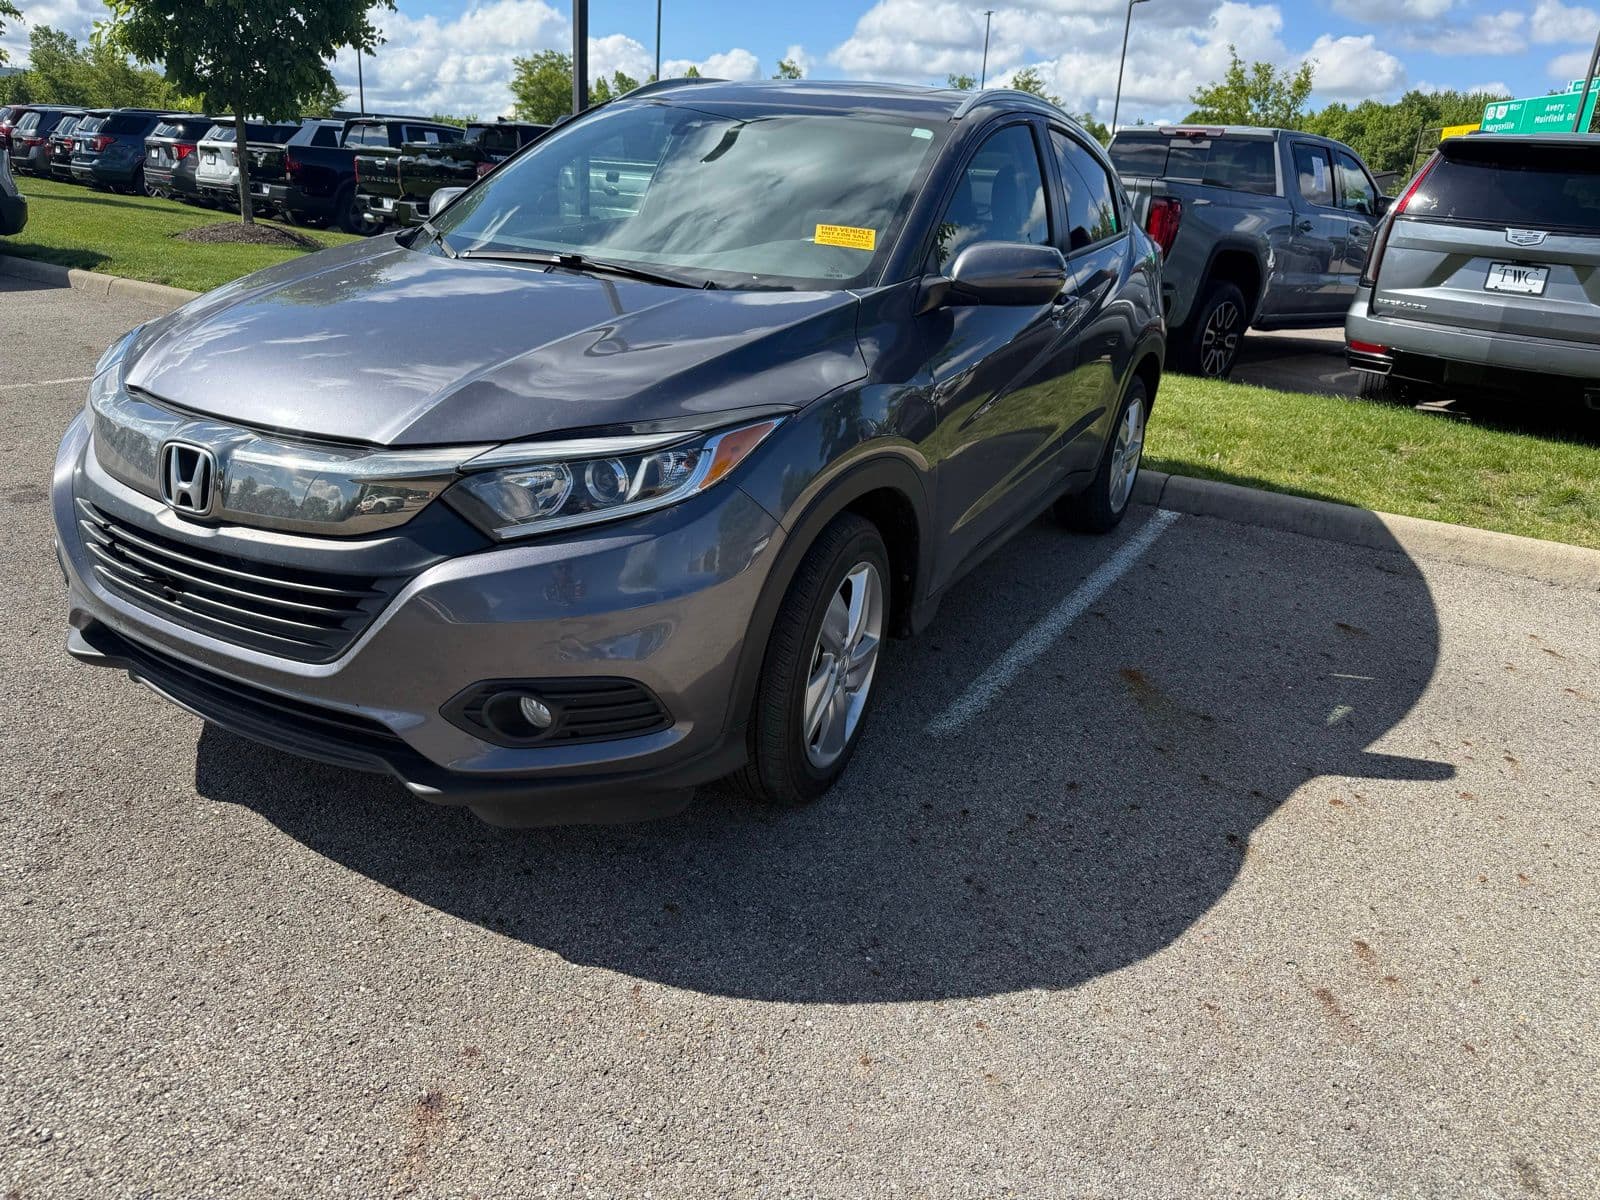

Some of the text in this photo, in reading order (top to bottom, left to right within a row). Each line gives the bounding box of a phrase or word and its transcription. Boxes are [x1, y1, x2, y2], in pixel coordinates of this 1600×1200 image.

[1545, 103, 1565, 113] Avery
[1534, 112, 1565, 124] Muirfield
[1485, 121, 1515, 133] Marysville
[839, 227, 873, 236] VEHICLE
[1498, 268, 1540, 285] TWC
